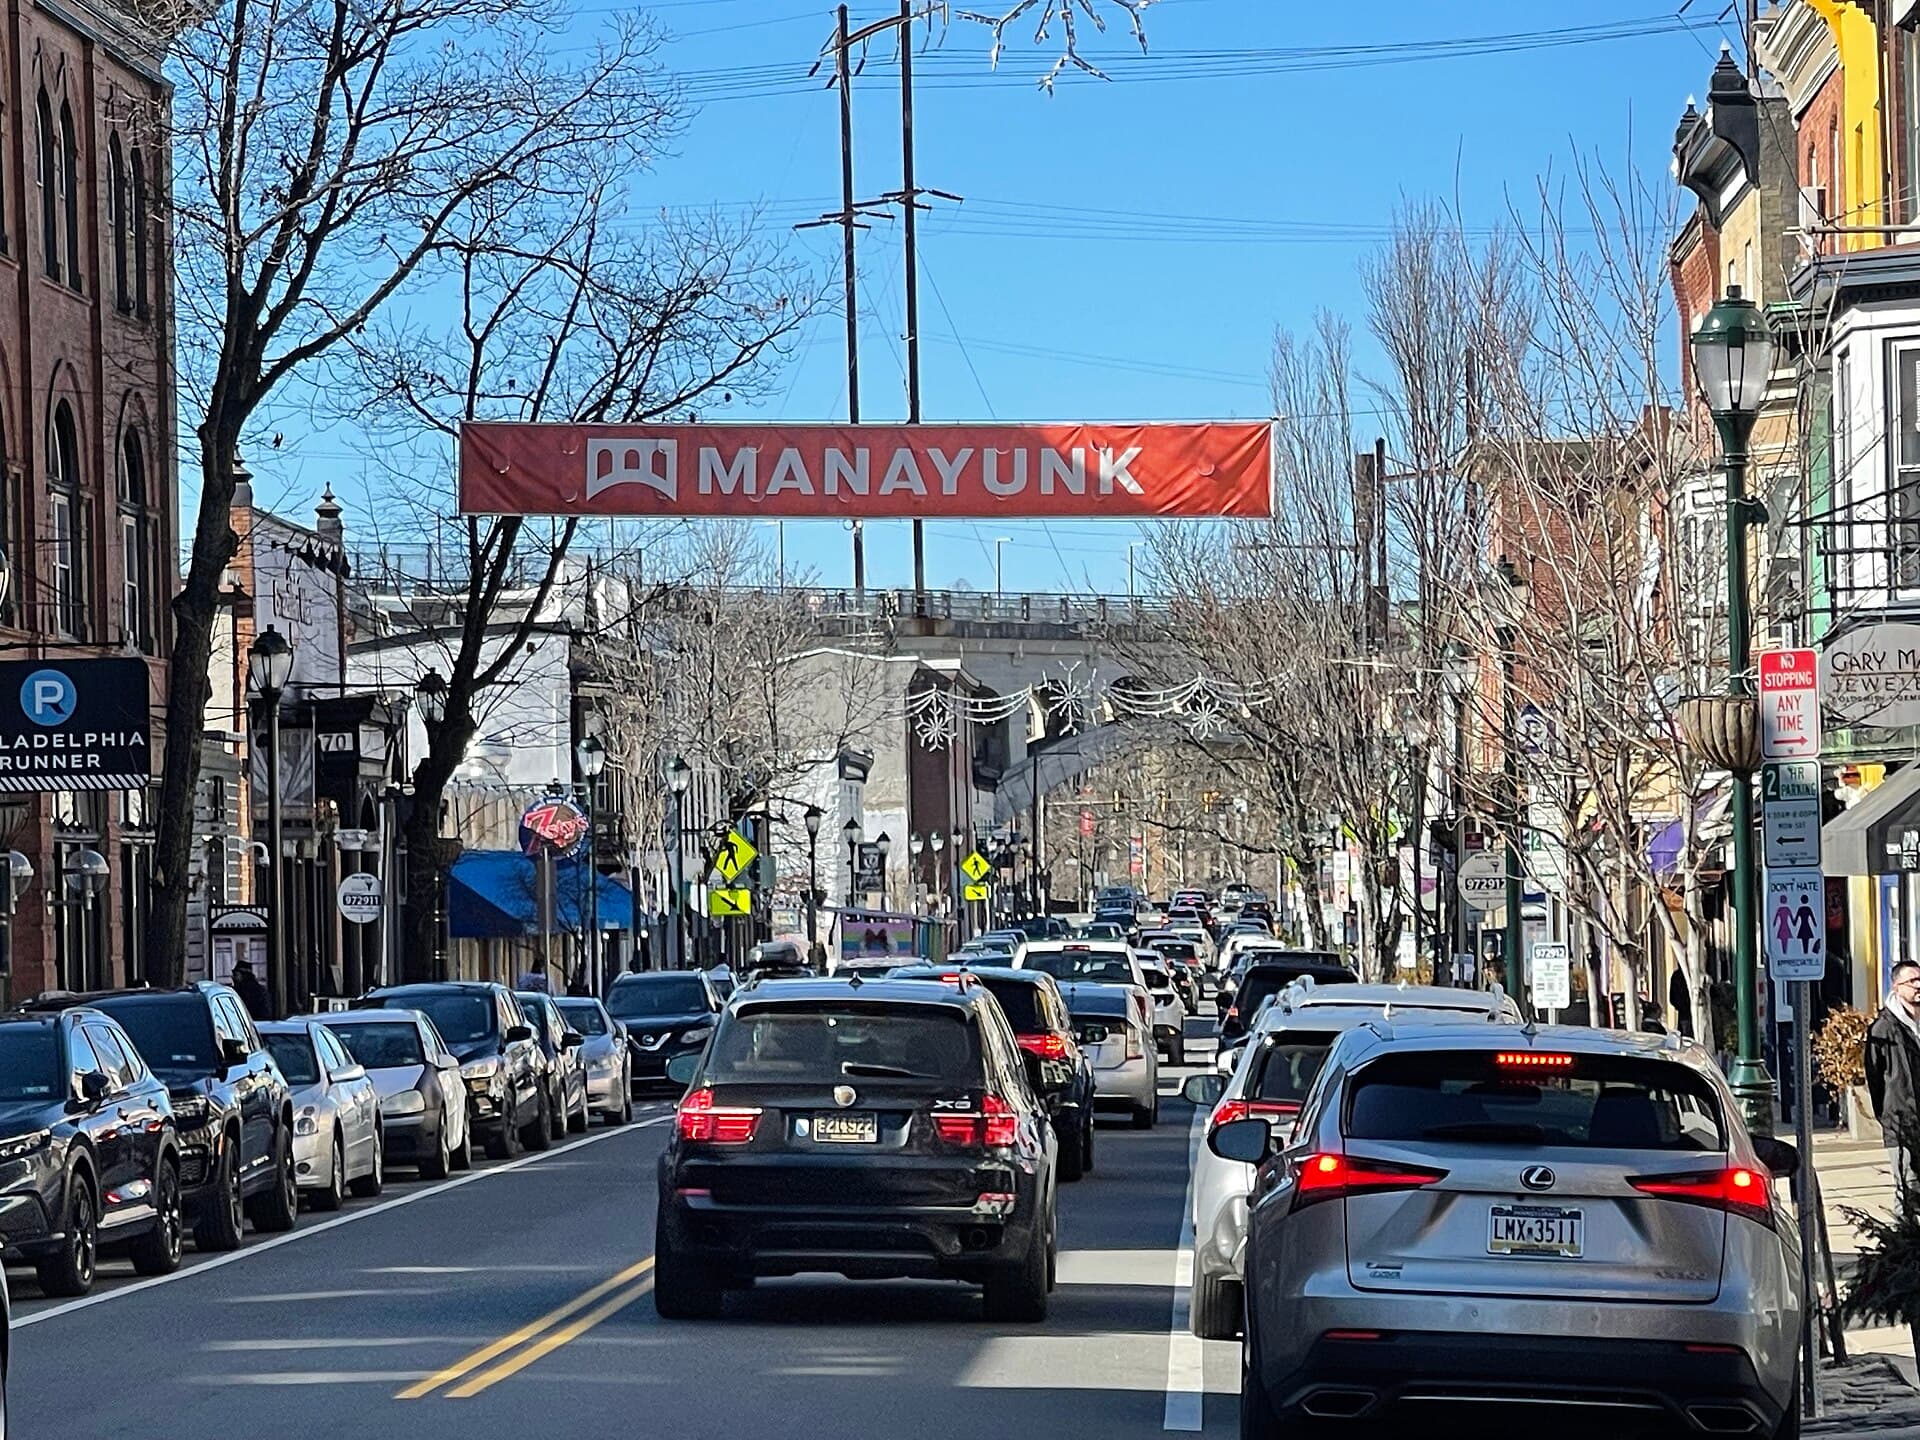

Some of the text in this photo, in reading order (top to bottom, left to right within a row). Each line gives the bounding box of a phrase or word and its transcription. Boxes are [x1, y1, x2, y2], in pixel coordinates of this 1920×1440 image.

[699, 446, 1145, 495] MANAYUNK
[1781, 653, 1795, 669] NO
[1831, 651, 1886, 672] GARY
[1764, 671, 1813, 687] STOPPING
[1777, 695, 1802, 712] ANY
[1776, 714, 1804, 732] TIME
[0, 754, 101, 770] RUNNER
[1766, 767, 1804, 796] 2 HR
[1781, 783, 1816, 797] PARKING
[1771, 881, 1819, 893] DON'T HATE
[345, 895, 379, 905] 972911
